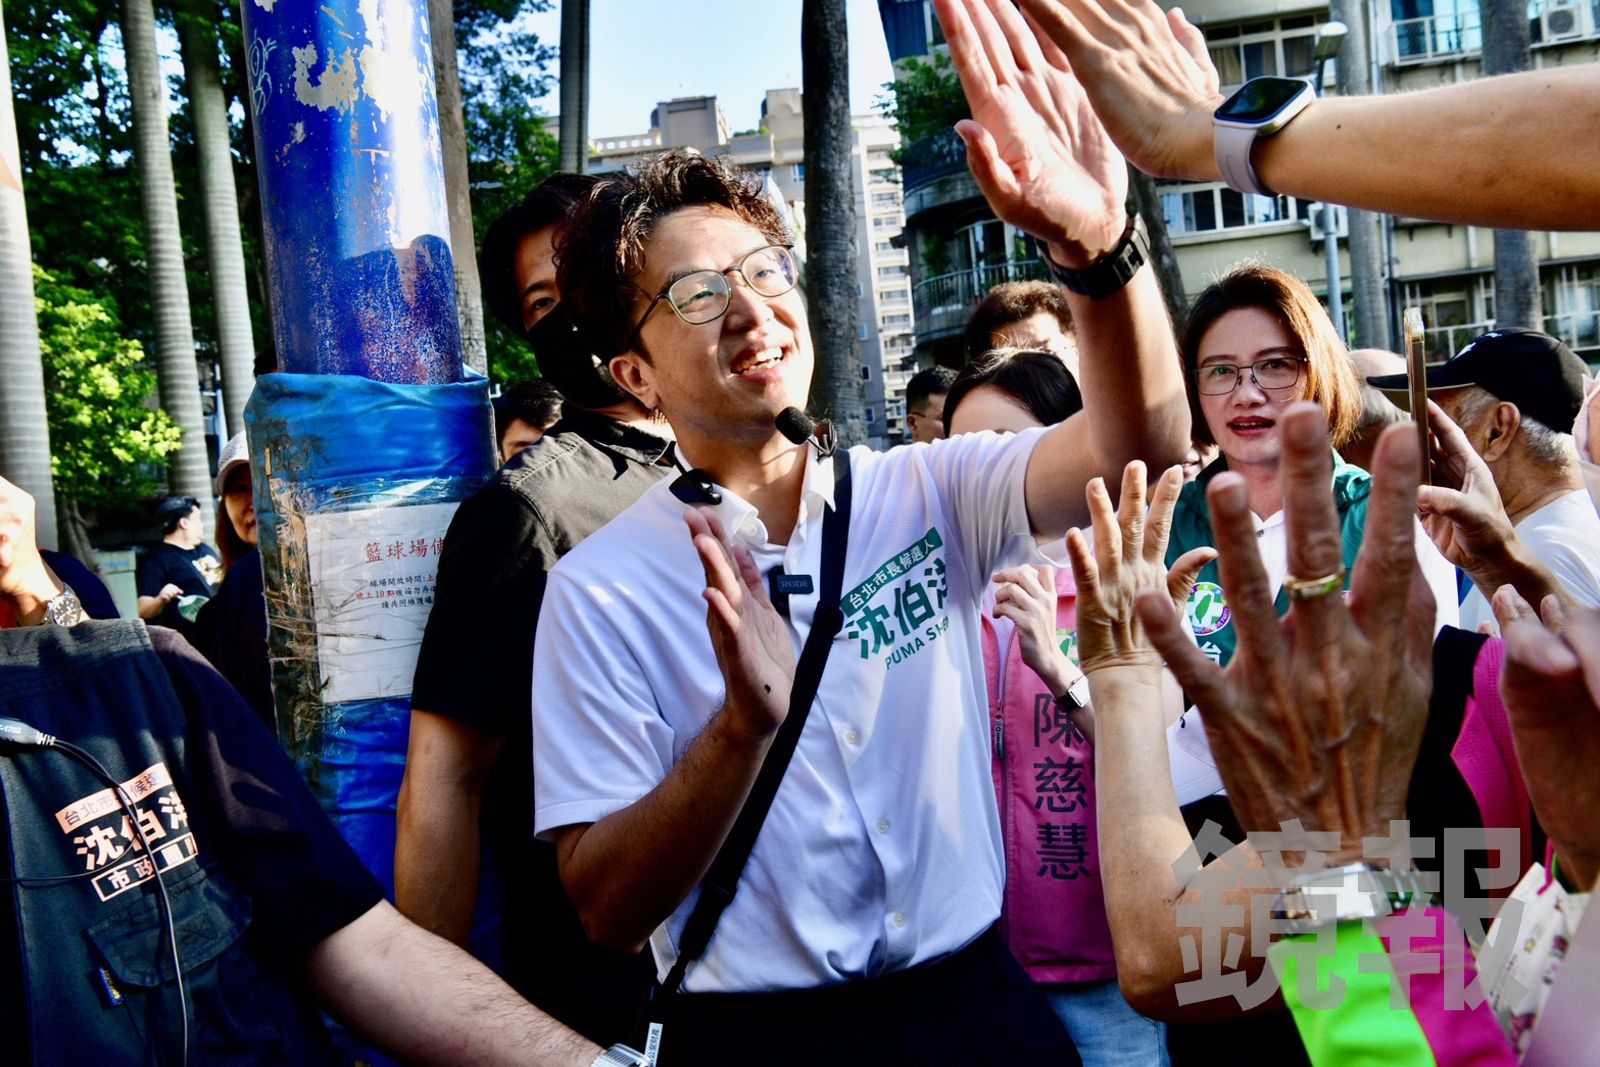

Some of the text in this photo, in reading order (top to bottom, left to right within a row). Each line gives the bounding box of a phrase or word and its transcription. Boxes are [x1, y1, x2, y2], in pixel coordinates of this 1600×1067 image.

[370, 574, 437, 587] 球場開放時間:上
[849, 539, 935, 609] 台北市長候選人
[885, 636, 925, 670] PUMA
[1033, 693, 1091, 881] 陳慈慧
